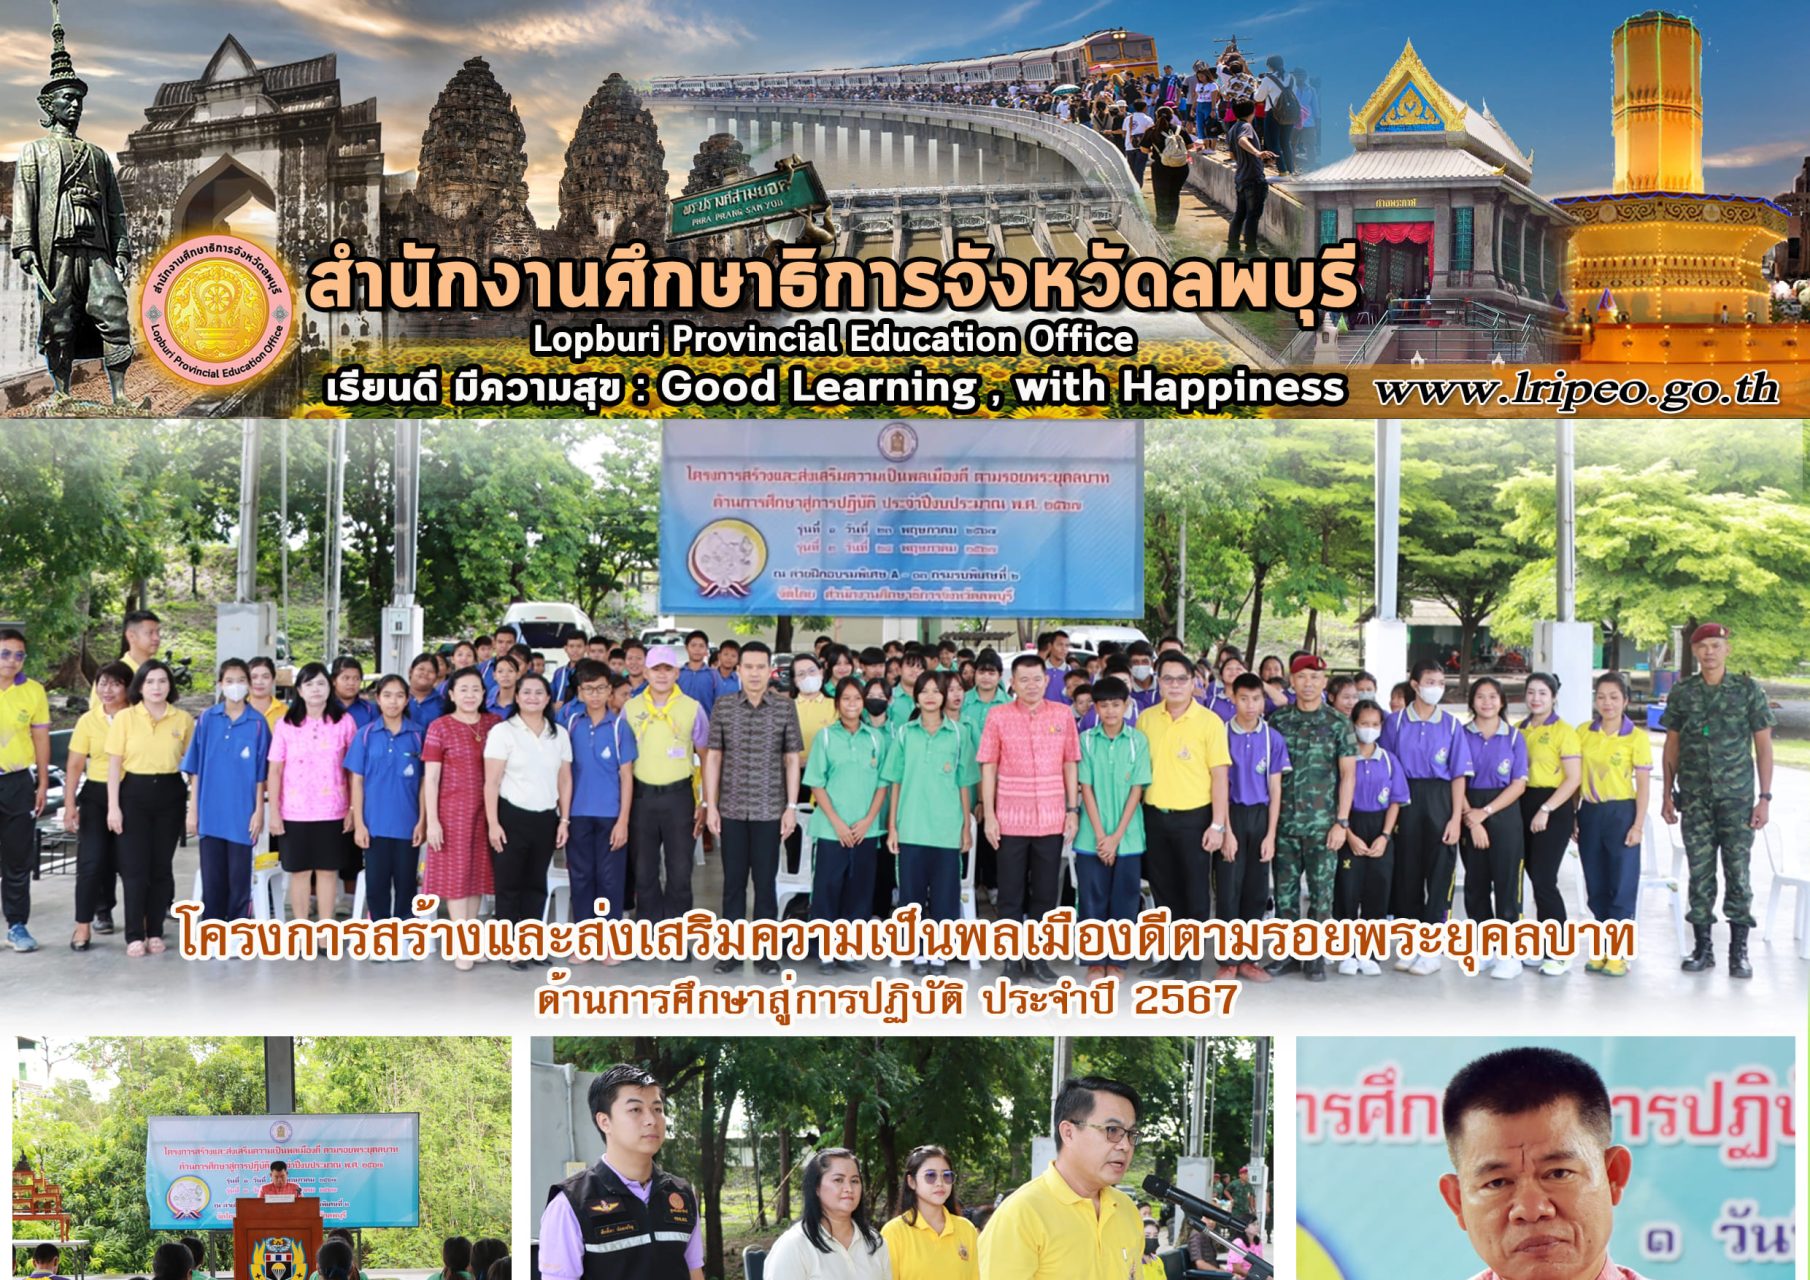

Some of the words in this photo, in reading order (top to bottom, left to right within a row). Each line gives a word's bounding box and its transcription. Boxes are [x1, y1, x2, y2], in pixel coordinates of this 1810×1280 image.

[715, 209, 743, 221] PRANG
[687, 465, 969, 484] โครงการสร้างและส่งเสริมความเป็นพลเมืองดี
[974, 469, 1110, 487] ตามรอยพระยุคลบาท
[712, 493, 877, 515] ด้านการศึกษาสู่การปฏิบัติ
[883, 494, 1005, 511] ประจำปีงบประมาณ
[1012, 497, 1038, 511] พ.ศ.
[901, 526, 958, 538] พฤษภาคม
